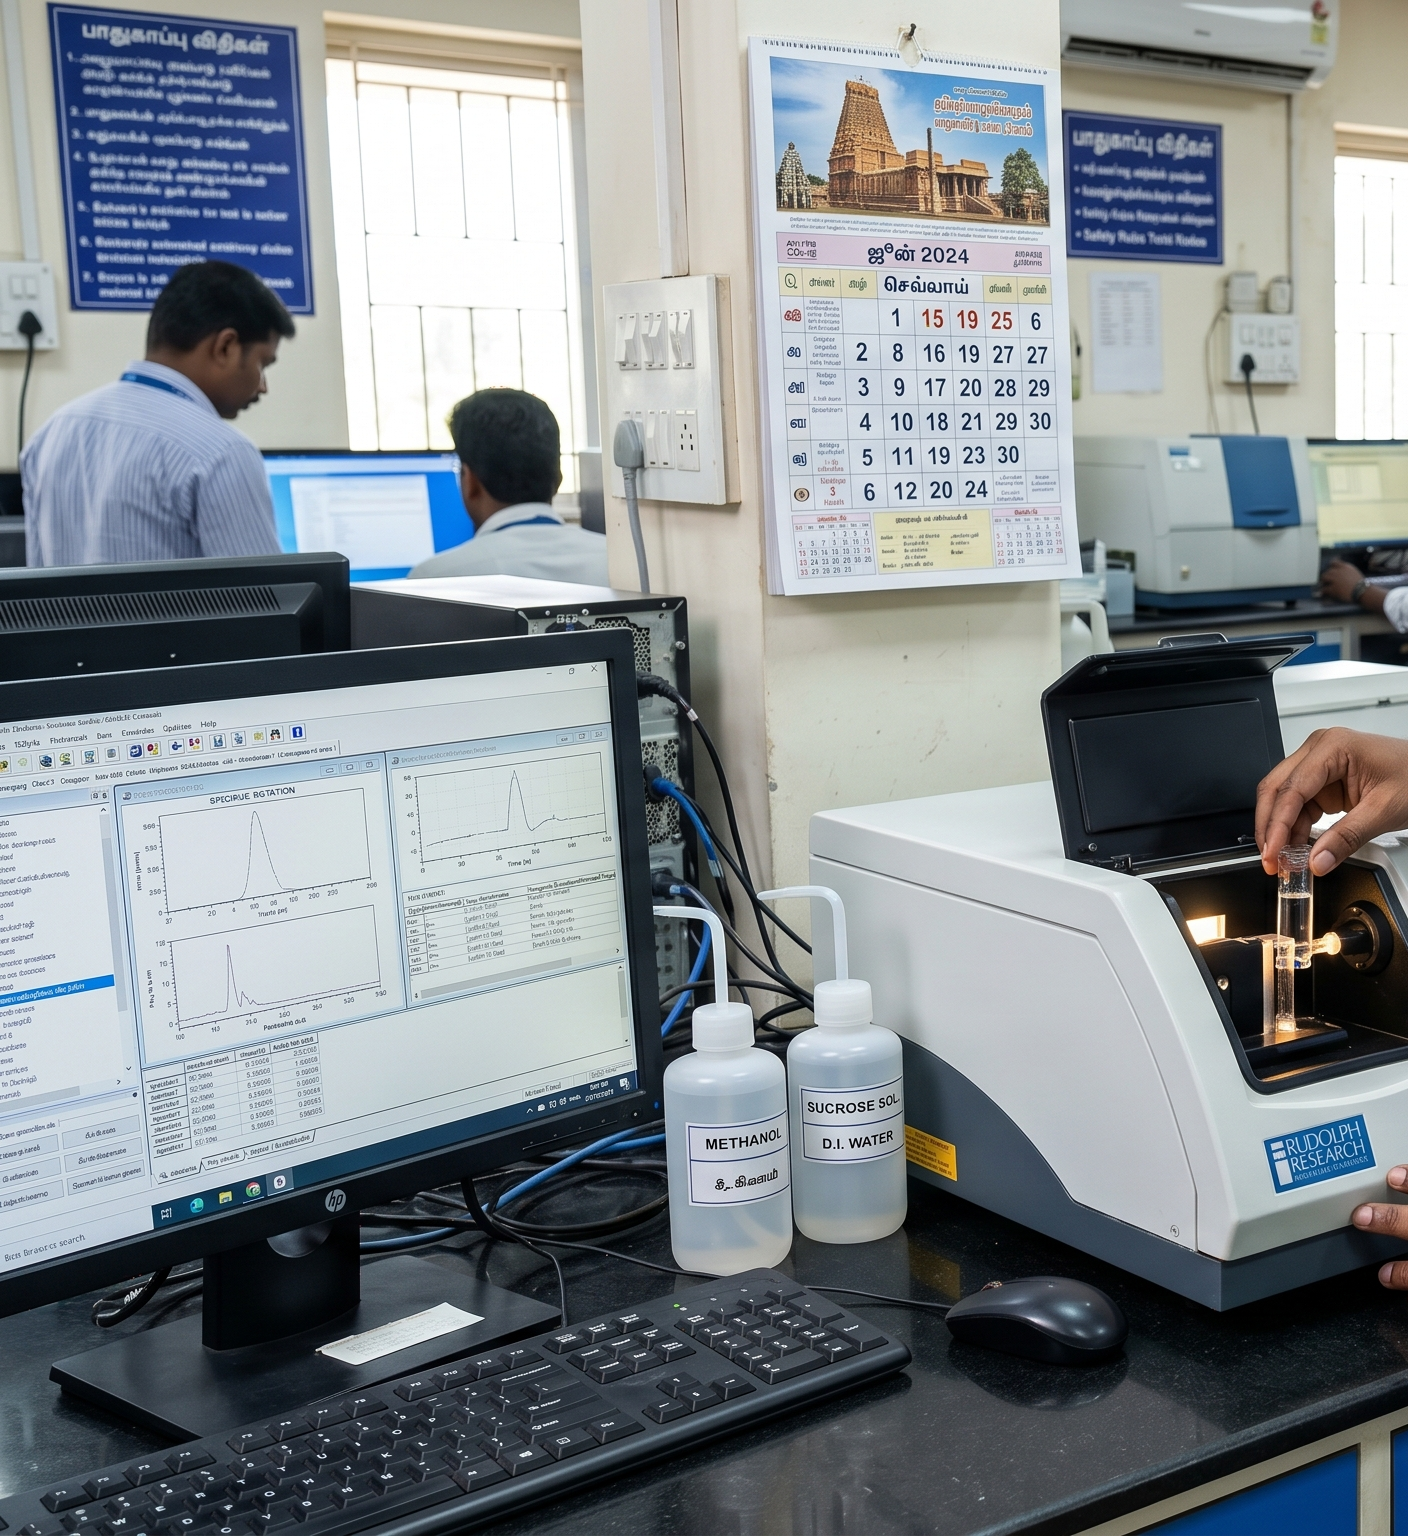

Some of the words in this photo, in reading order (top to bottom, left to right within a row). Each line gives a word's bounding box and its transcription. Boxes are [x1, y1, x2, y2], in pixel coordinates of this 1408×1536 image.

[81, 23, 188, 51] பாதுகாப்பு
[191, 29, 270, 55] விதிகள்
[1072, 129, 1154, 159] பாதுகாப்பு
[1156, 132, 1214, 160] விதிகள்
[921, 247, 969, 264] 2024
[892, 308, 899, 326] 1
[922, 309, 943, 328] 15
[957, 310, 977, 329] 19
[991, 311, 1012, 330] 25
[1031, 312, 1041, 330] 6
[857, 343, 867, 361] 2
[893, 343, 903, 362] 8
[924, 344, 945, 362] 16
[959, 345, 979, 363] 19
[993, 346, 1013, 363] 27
[1027, 346, 1047, 364] 27
[858, 378, 869, 396] 3
[894, 378, 904, 396] 9
[925, 378, 946, 396] 17
[960, 379, 981, 396] 20
[995, 379, 1016, 397] 28
[1029, 379, 1049, 397] 29
[860, 413, 871, 431] 4
[891, 413, 913, 431] 10
[927, 413, 948, 431] 18
[962, 413, 981, 430] 21
[996, 413, 1017, 430] 29
[1030, 413, 1051, 430] 30
[863, 449, 872, 466] 5
[892, 447, 912, 465] 11
[928, 447, 950, 464] 19
[963, 446, 985, 464] 23
[998, 446, 1019, 463] 30
[864, 483, 875, 501] 6
[895, 482, 917, 500] 12
[930, 481, 952, 498] 20
[965, 480, 988, 498] 24
[807, 1100, 875, 1114] SUCROSE
[878, 1093, 900, 1109] SOL.
[705, 1127, 782, 1150] METHANOL
[822, 1138, 845, 1150] D.I.
[848, 1130, 894, 1149] WATER
[1285, 1120, 1361, 1156] RUDOLPH
[1289, 1138, 1366, 1173] RESEARCH
[327, 1190, 344, 1212] hp
[59, 1234, 86, 1247] search
